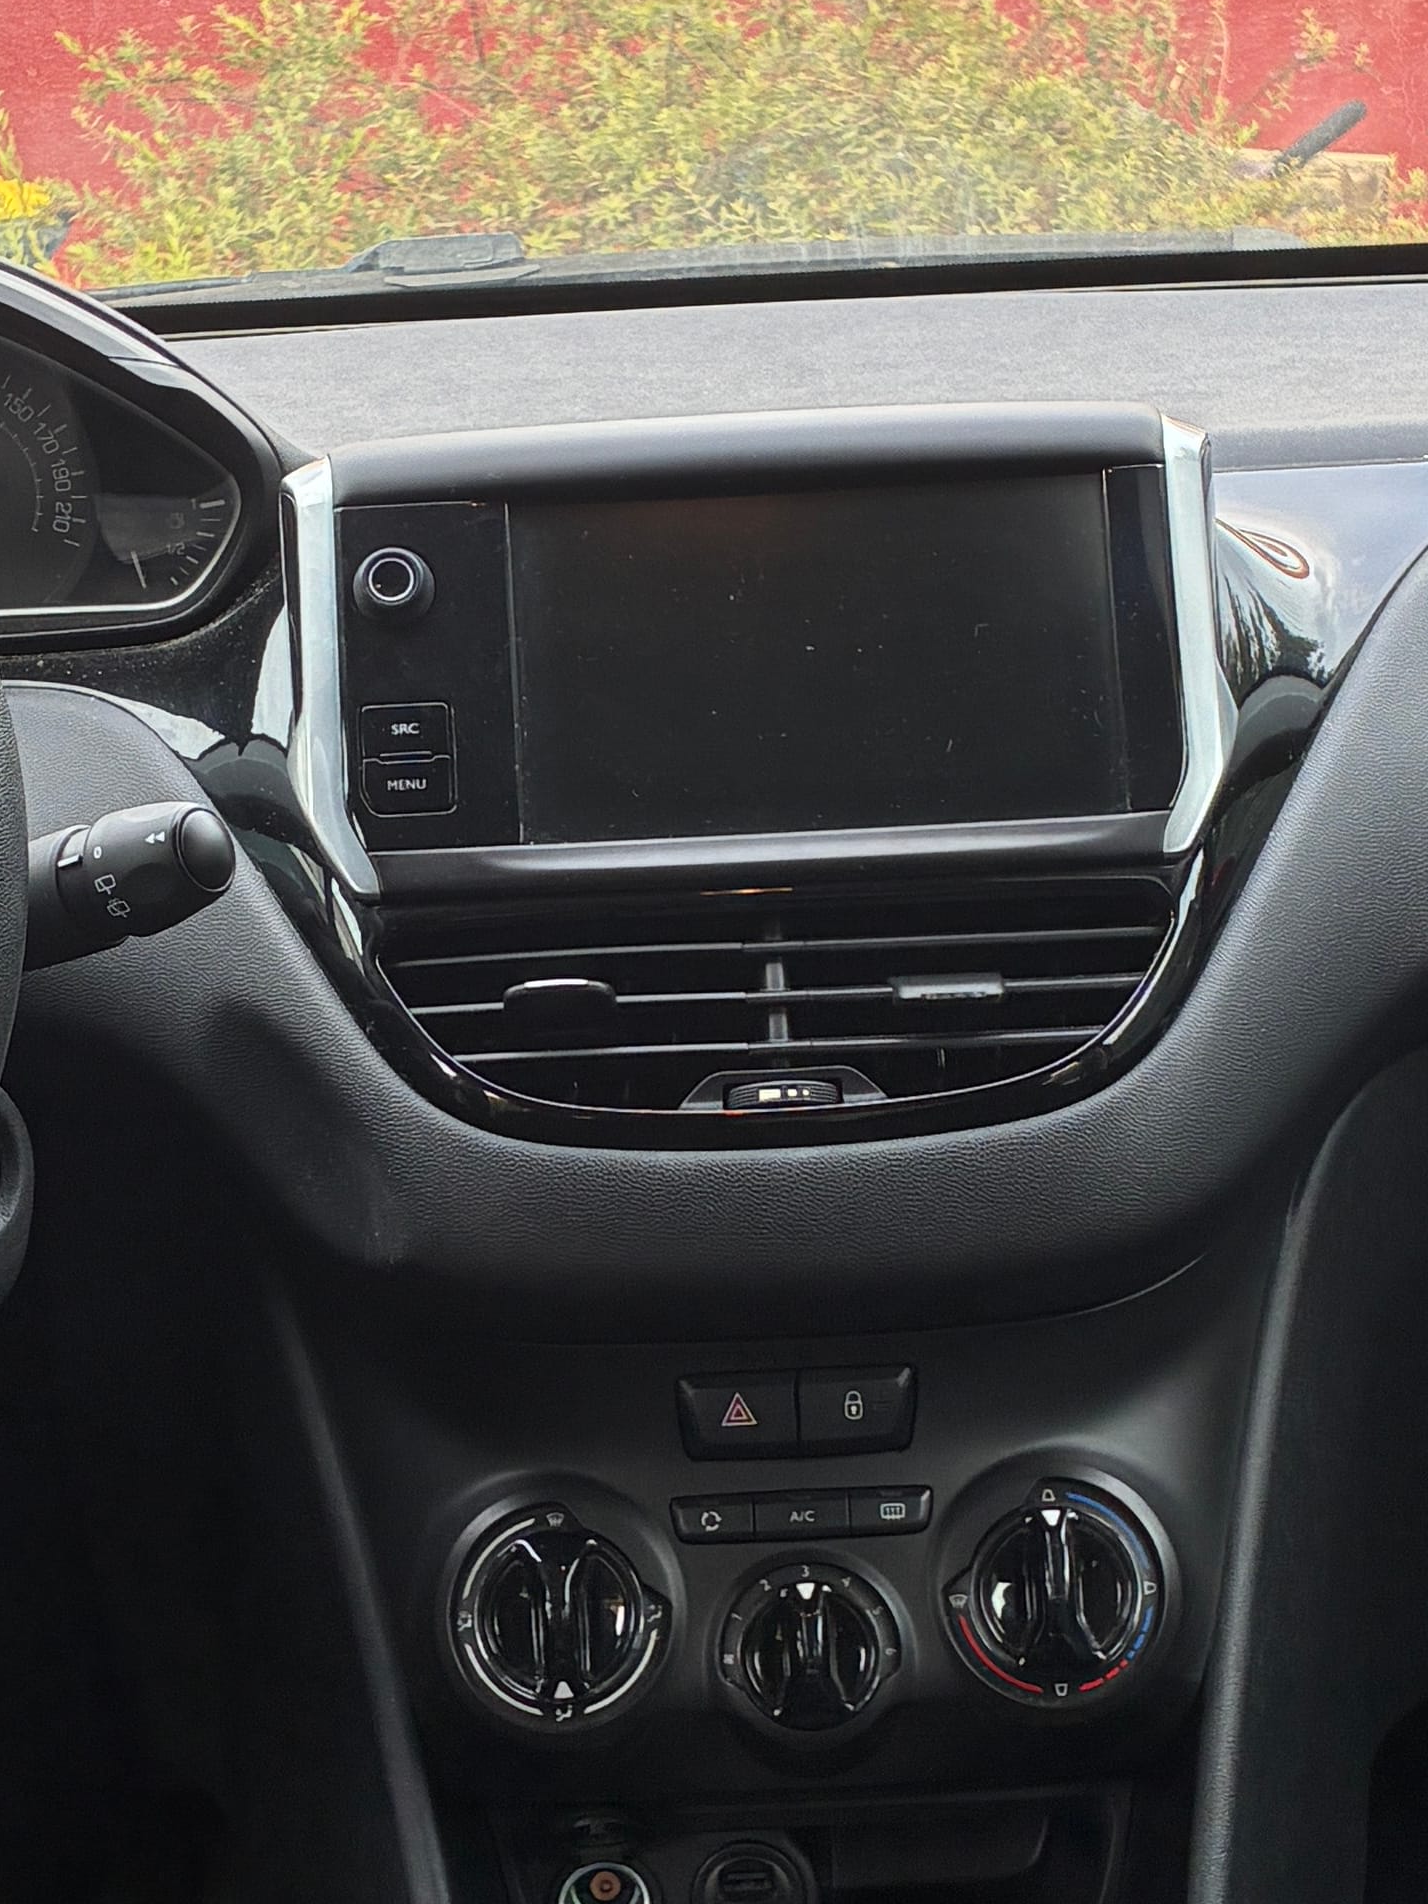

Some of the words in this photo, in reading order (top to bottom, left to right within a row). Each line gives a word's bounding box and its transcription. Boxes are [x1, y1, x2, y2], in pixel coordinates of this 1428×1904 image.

[3, 392, 35, 422] 150
[32, 422, 60, 454] 170
[51, 458, 71, 492] 190
[52, 502, 72, 533] 210
[391, 722, 421, 736] SRC
[387, 778, 427, 791] MENU
[789, 1509, 816, 1523] A/C
[800, 1564, 811, 1578] 3
[759, 1578, 772, 1592] 2
